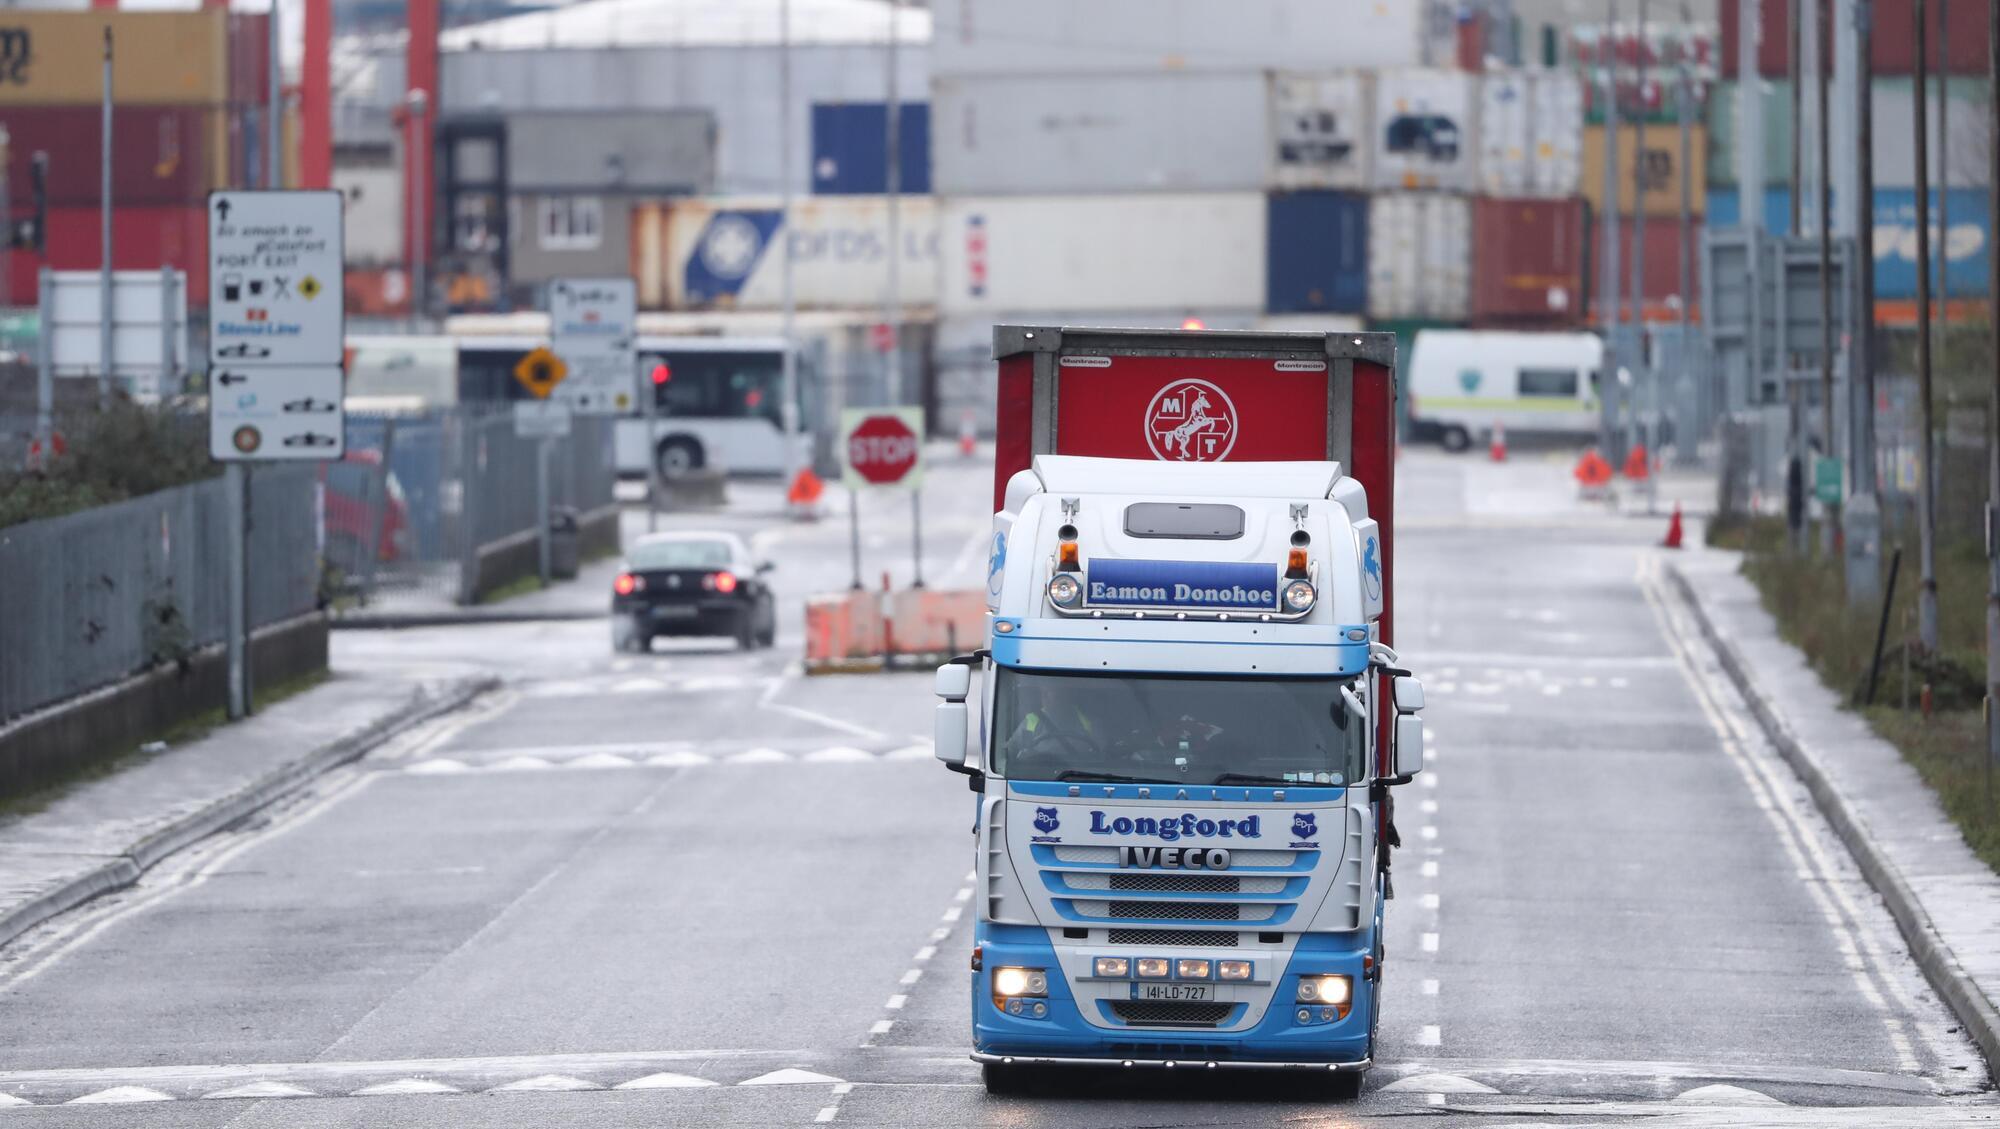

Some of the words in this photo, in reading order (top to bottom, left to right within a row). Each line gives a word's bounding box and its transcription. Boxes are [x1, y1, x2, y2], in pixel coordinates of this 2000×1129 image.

[217, 254, 257, 267] PORT
[264, 254, 298, 267] EXIT
[1162, 398, 1181, 414] M
[849, 435, 917, 464] STOP
[1205, 438, 1217, 454] T
[1090, 582, 1166, 600] Eamon
[1174, 583, 1273, 603] Donohoe
[1068, 785, 1286, 801] STRALIS
[1089, 810, 1261, 841] Longford
[1119, 846, 1232, 871] IVECO
[1146, 985, 1206, 1000] 141-LD-727
